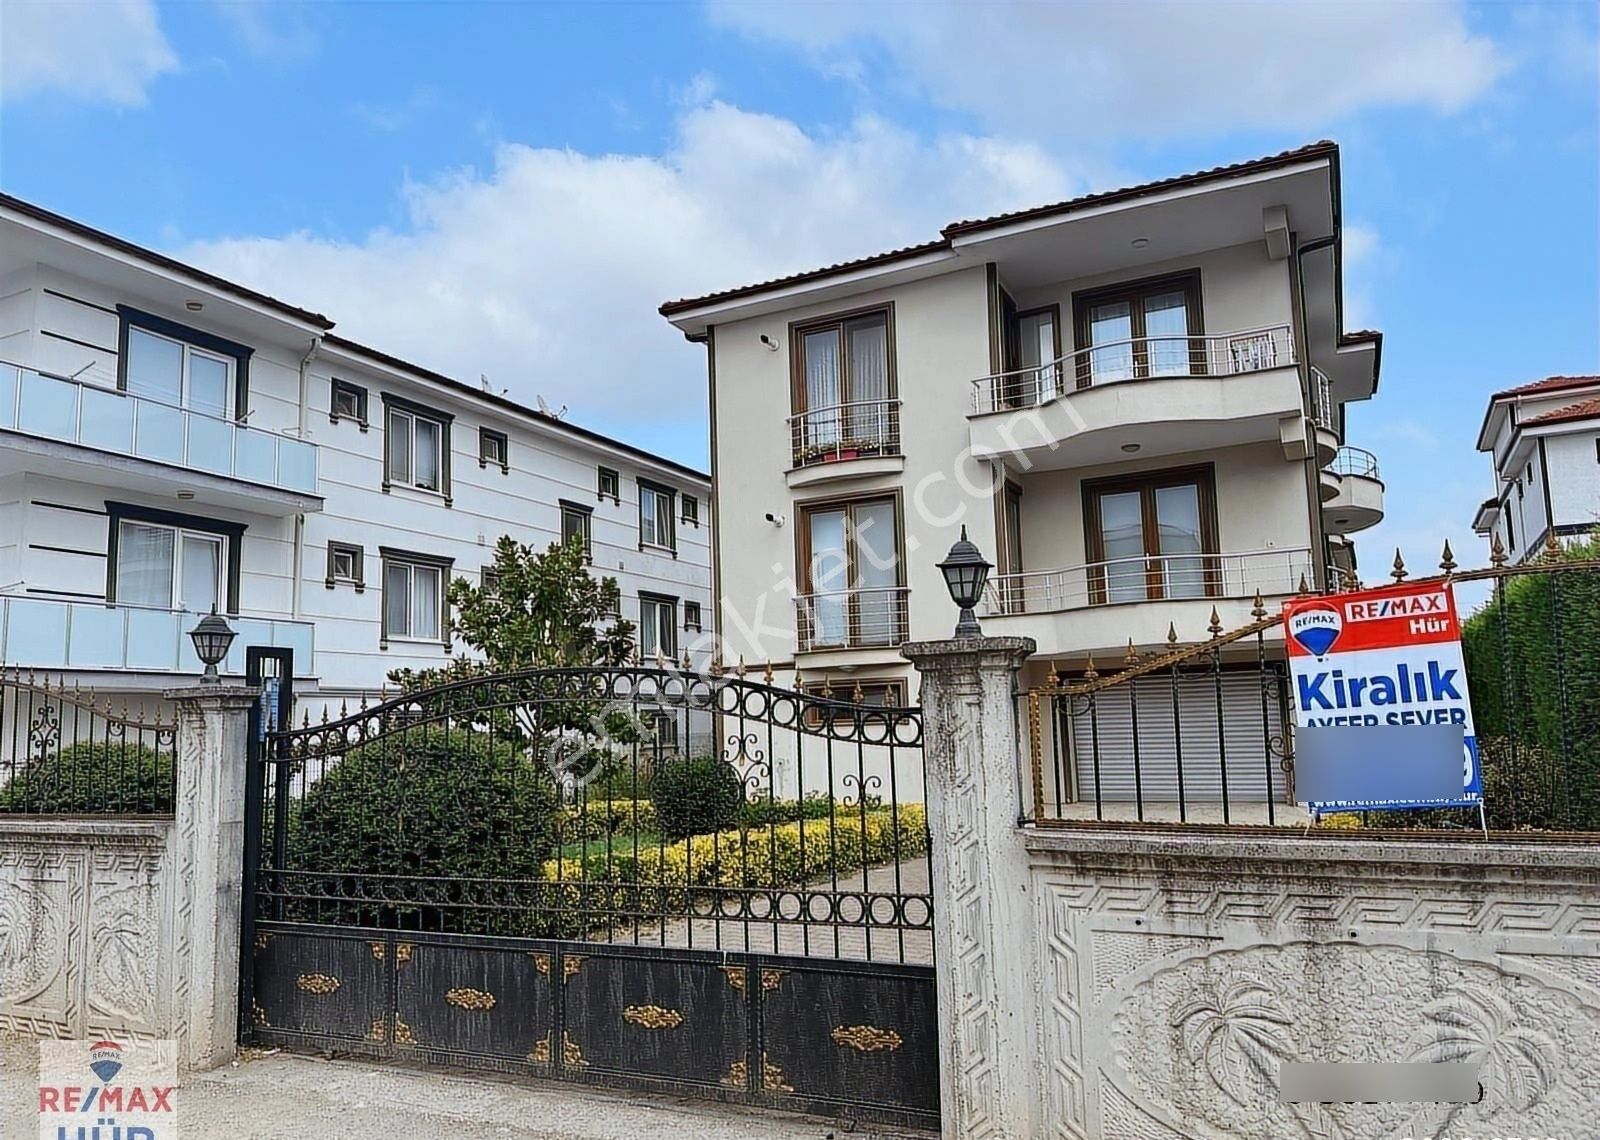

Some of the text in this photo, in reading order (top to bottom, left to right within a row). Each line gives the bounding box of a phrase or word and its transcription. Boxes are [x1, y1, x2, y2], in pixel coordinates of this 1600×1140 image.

[1350, 594, 1442, 620] RE/MAX
[1295, 615, 1336, 628] RE/MAX
[1410, 618, 1450, 635] Hür
[1297, 661, 1463, 711] Kiralık
